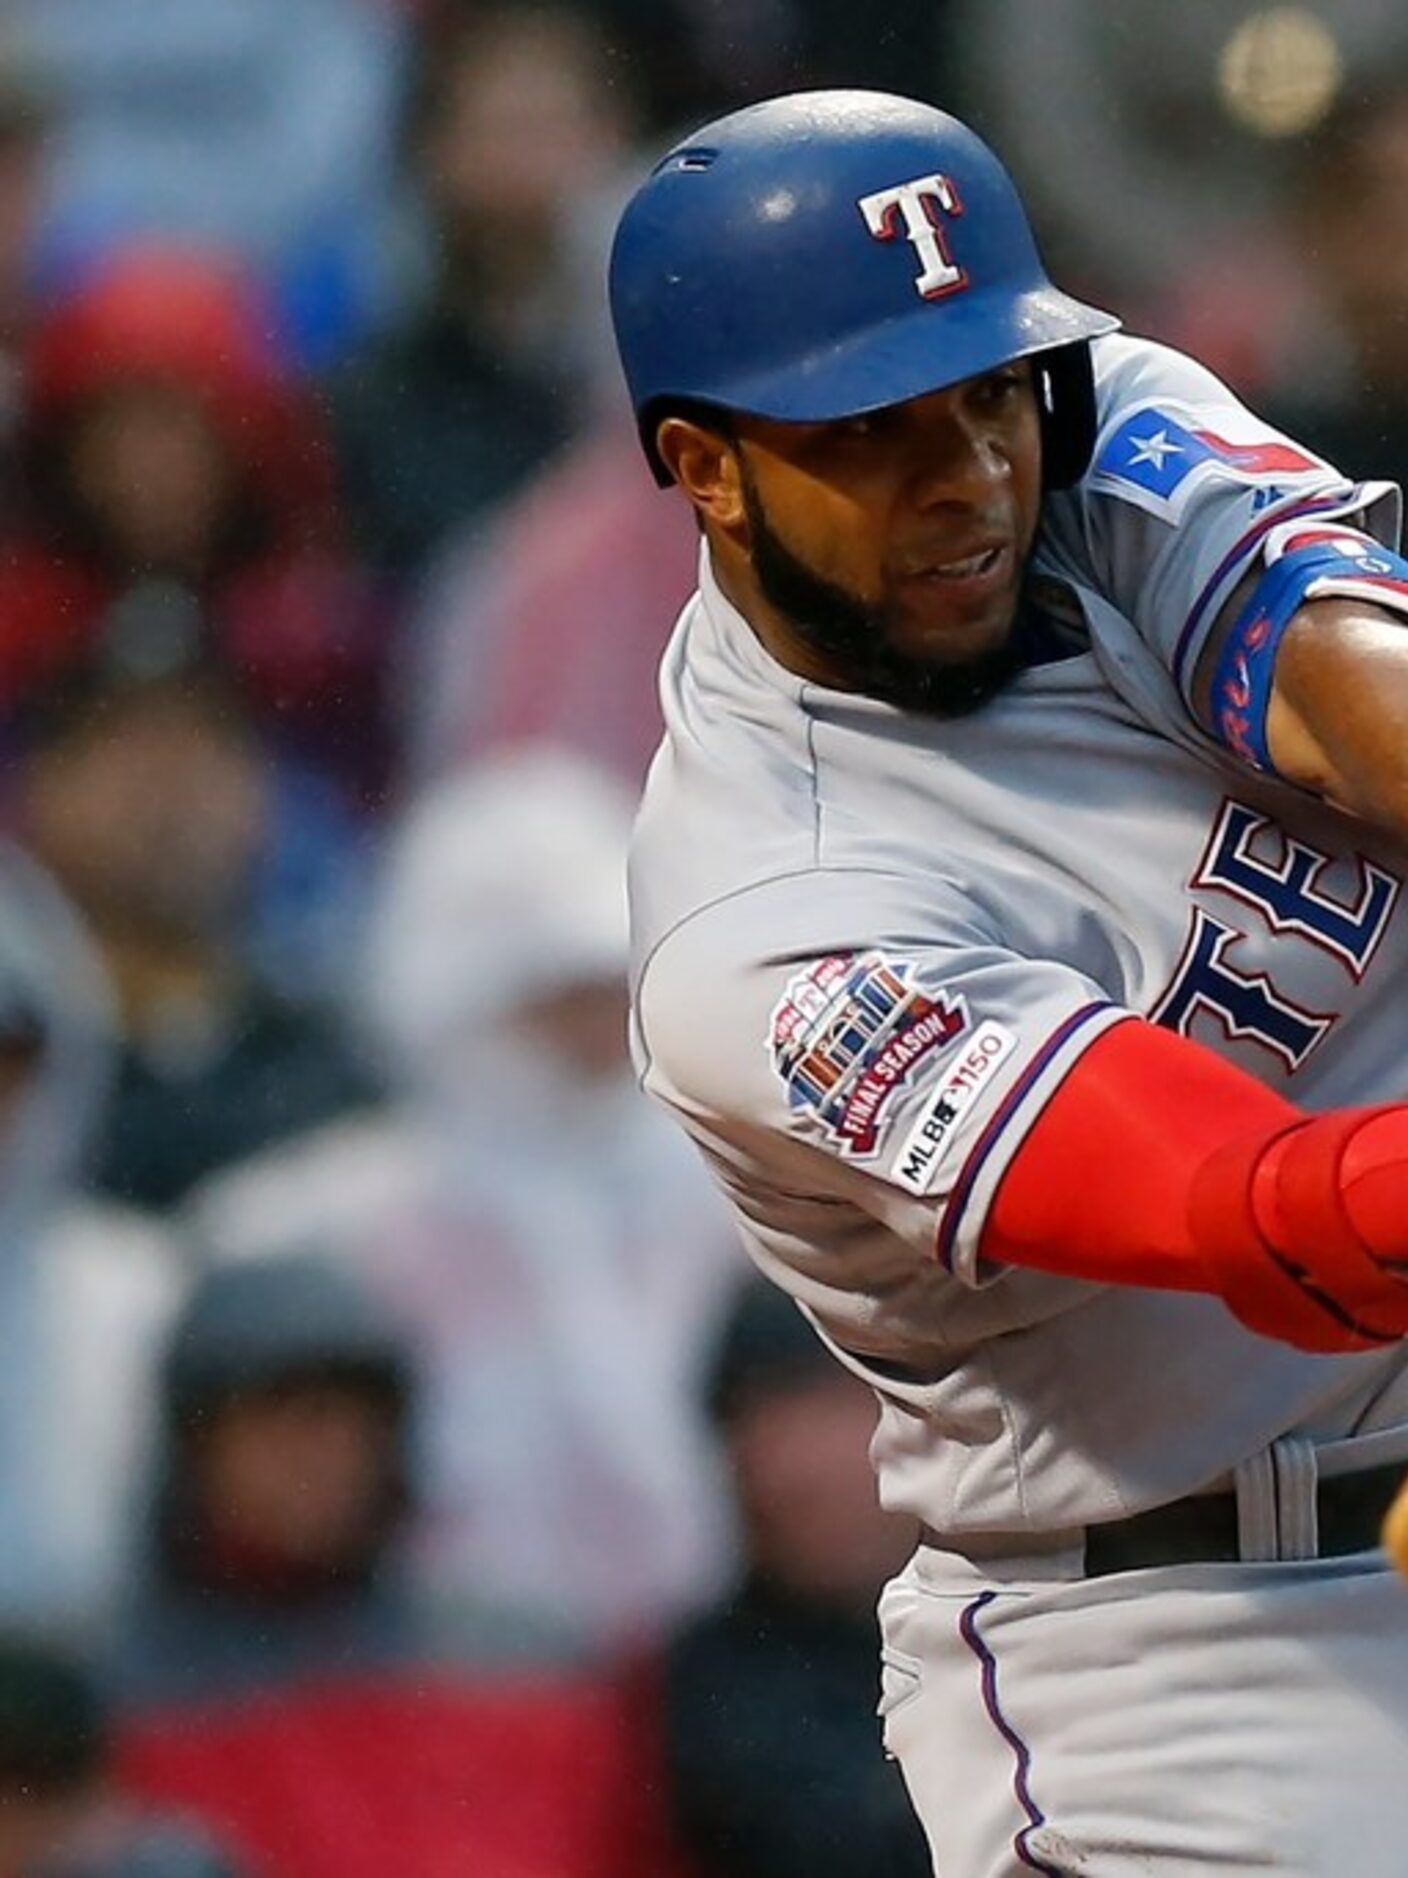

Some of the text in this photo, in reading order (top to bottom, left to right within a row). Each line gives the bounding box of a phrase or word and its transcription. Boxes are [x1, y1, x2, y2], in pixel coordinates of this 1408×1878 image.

[856, 170, 970, 300] T
[843, 1013, 947, 1135] FINAL SEASON
[901, 1034, 1003, 1184] MLB 150
